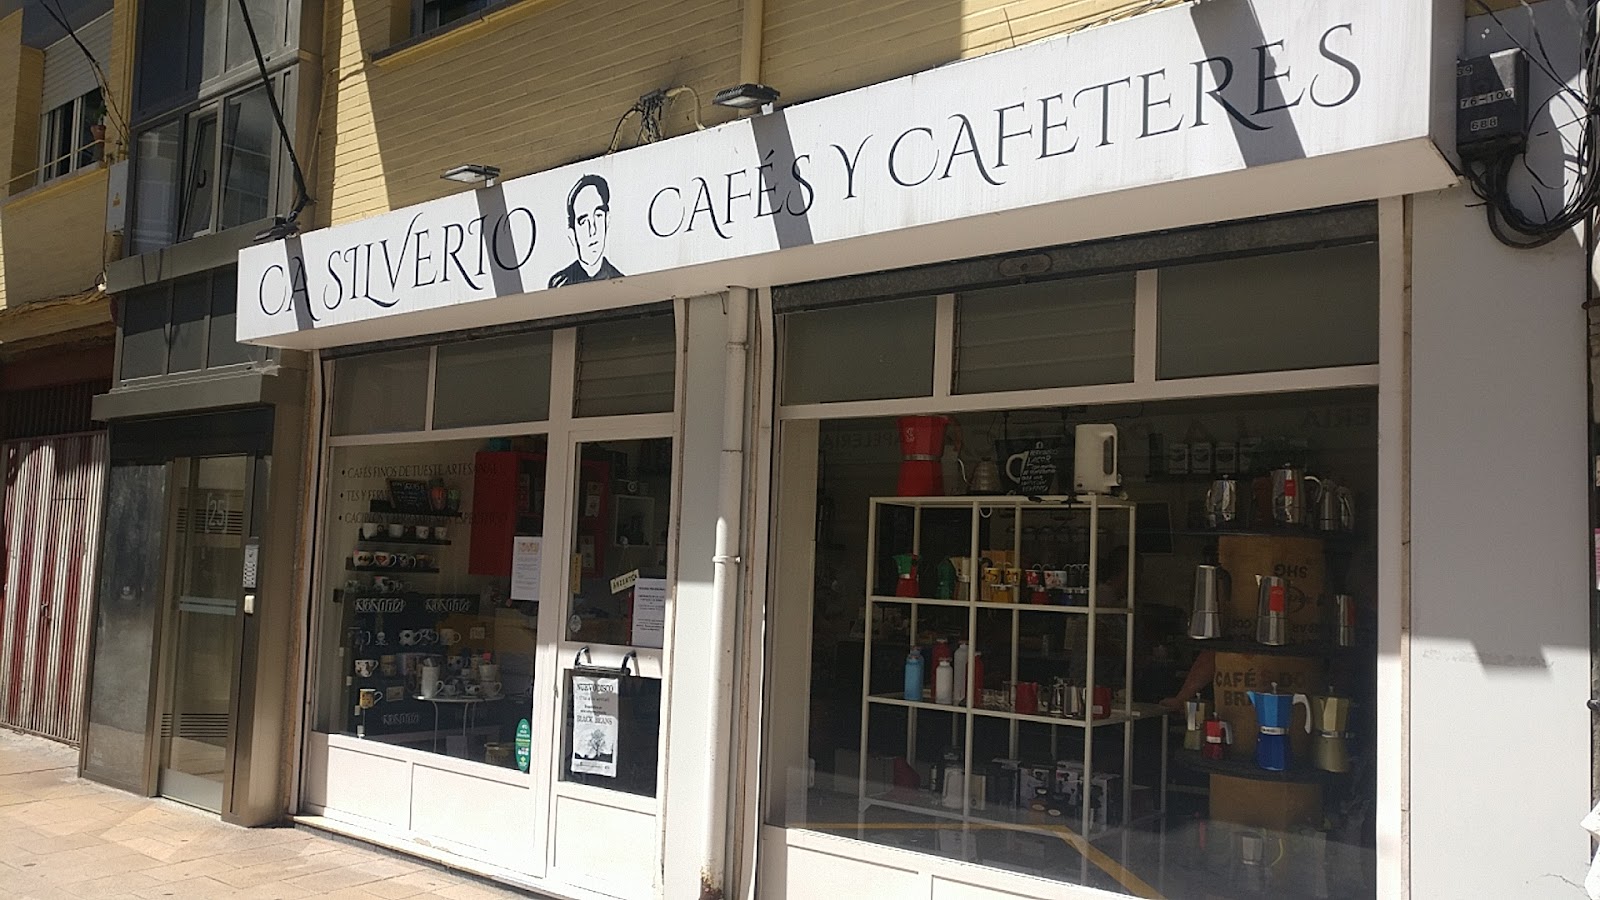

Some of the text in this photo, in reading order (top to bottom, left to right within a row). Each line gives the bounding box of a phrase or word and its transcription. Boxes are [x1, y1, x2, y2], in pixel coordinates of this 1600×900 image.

[648, 23, 1360, 239] CAFÉS Y CAFETERES
[1471, 118, 1497, 130] 688
[259, 207, 536, 321] CA SILVERIO
[373, 466, 397, 478] FINOS
[399, 465, 411, 477] DE
[412, 463, 445, 477] TUESTE
[1274, 563, 1308, 579] SHG
